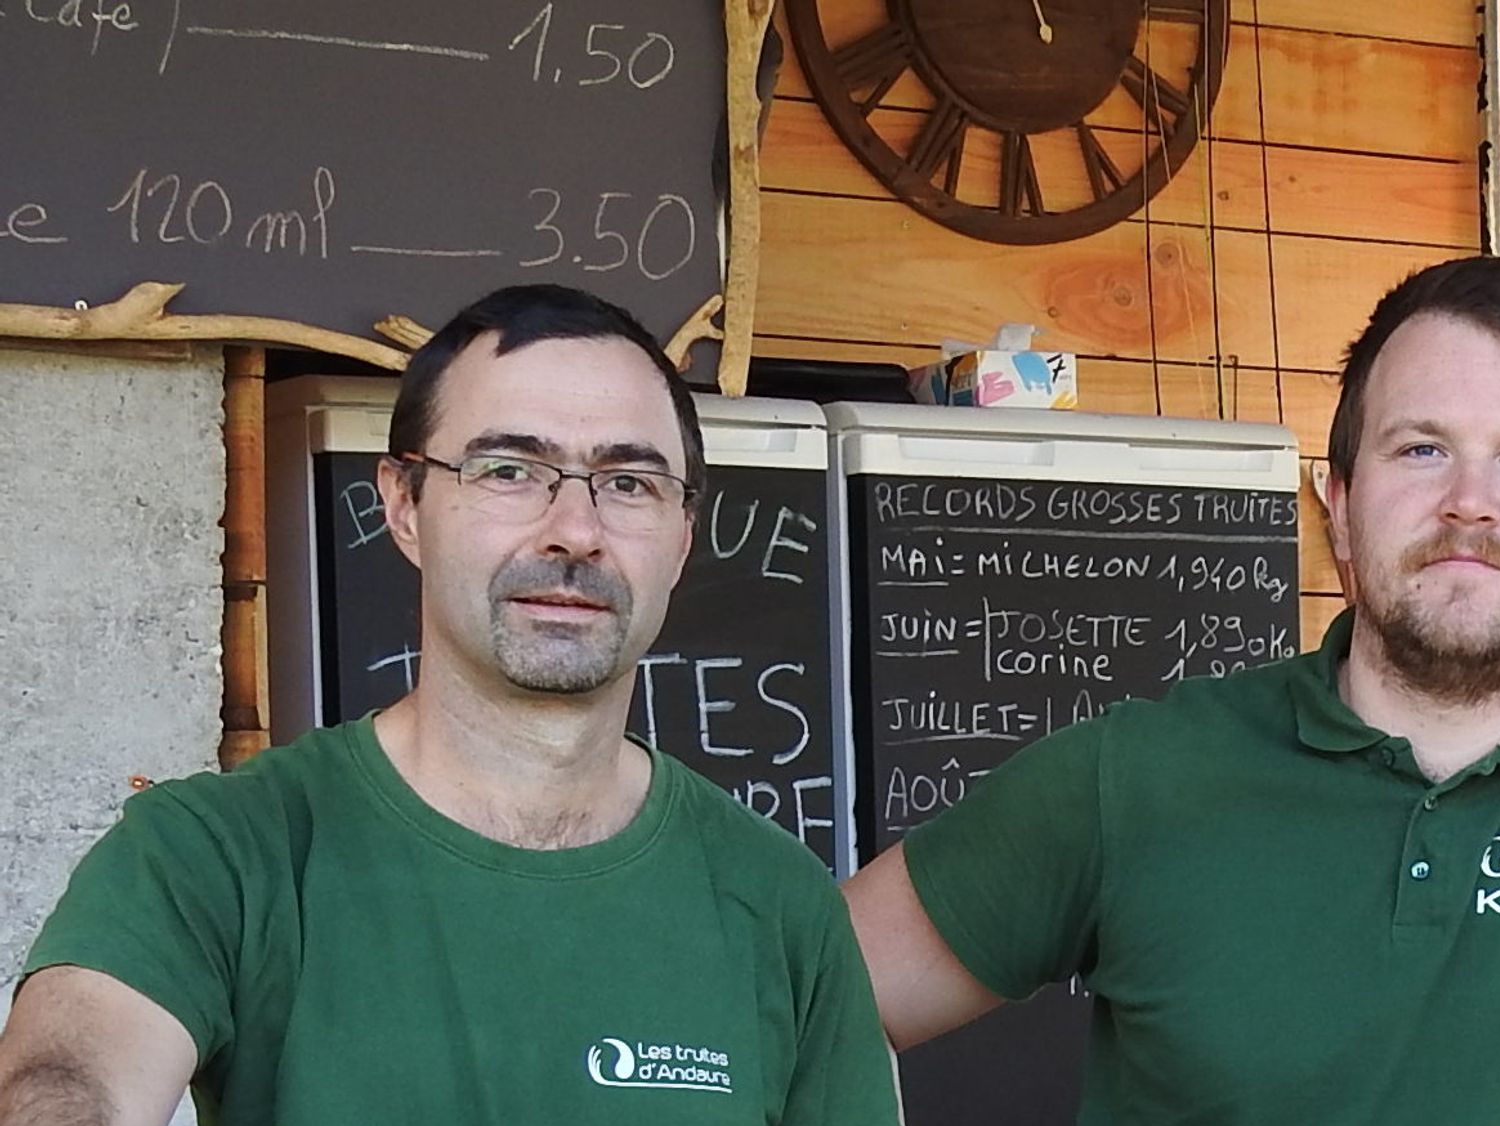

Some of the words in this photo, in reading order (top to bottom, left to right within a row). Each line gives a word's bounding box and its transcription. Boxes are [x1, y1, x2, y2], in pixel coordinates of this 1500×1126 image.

[107, 169, 232, 244] 120
[875, 482, 1036, 523] RECORDS
[1048, 487, 1181, 525] GROSSES
[989, 610, 1152, 648] JOSETTE
[637, 1042, 672, 1060] Les
[638, 1062, 731, 1086] d'Andaure
